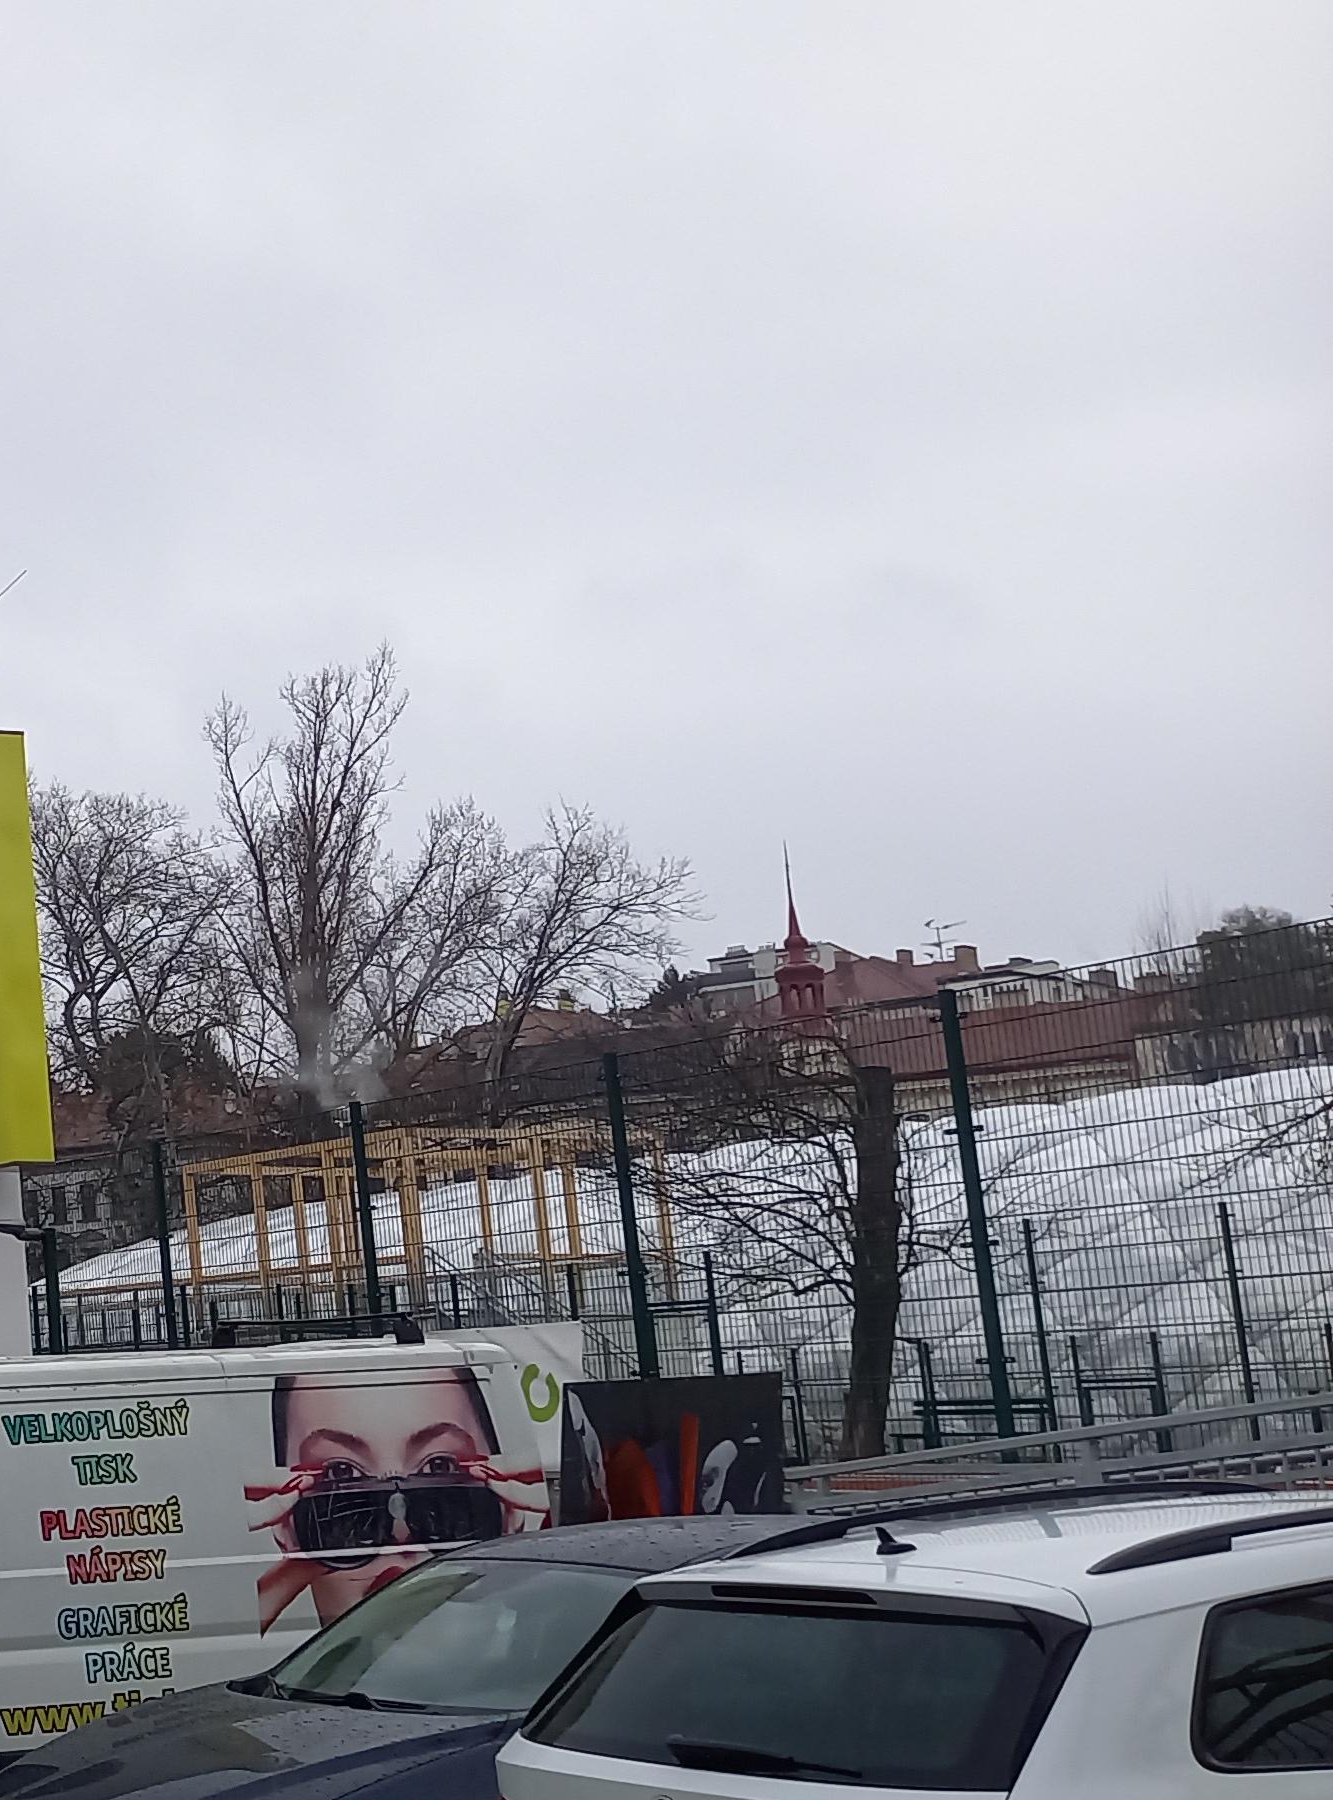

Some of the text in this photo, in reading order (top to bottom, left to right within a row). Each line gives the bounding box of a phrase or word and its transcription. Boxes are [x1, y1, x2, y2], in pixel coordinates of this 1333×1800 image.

[1, 1398, 190, 1446] VELKOPLOŠNÝ
[71, 1453, 137, 1486] TISK
[40, 1496, 183, 1541] PLASTICKÉ
[66, 1545, 167, 1585] NÁPISY
[58, 1593, 190, 1640] GRAFICKÉ
[85, 1642, 172, 1684] PRÁCE
